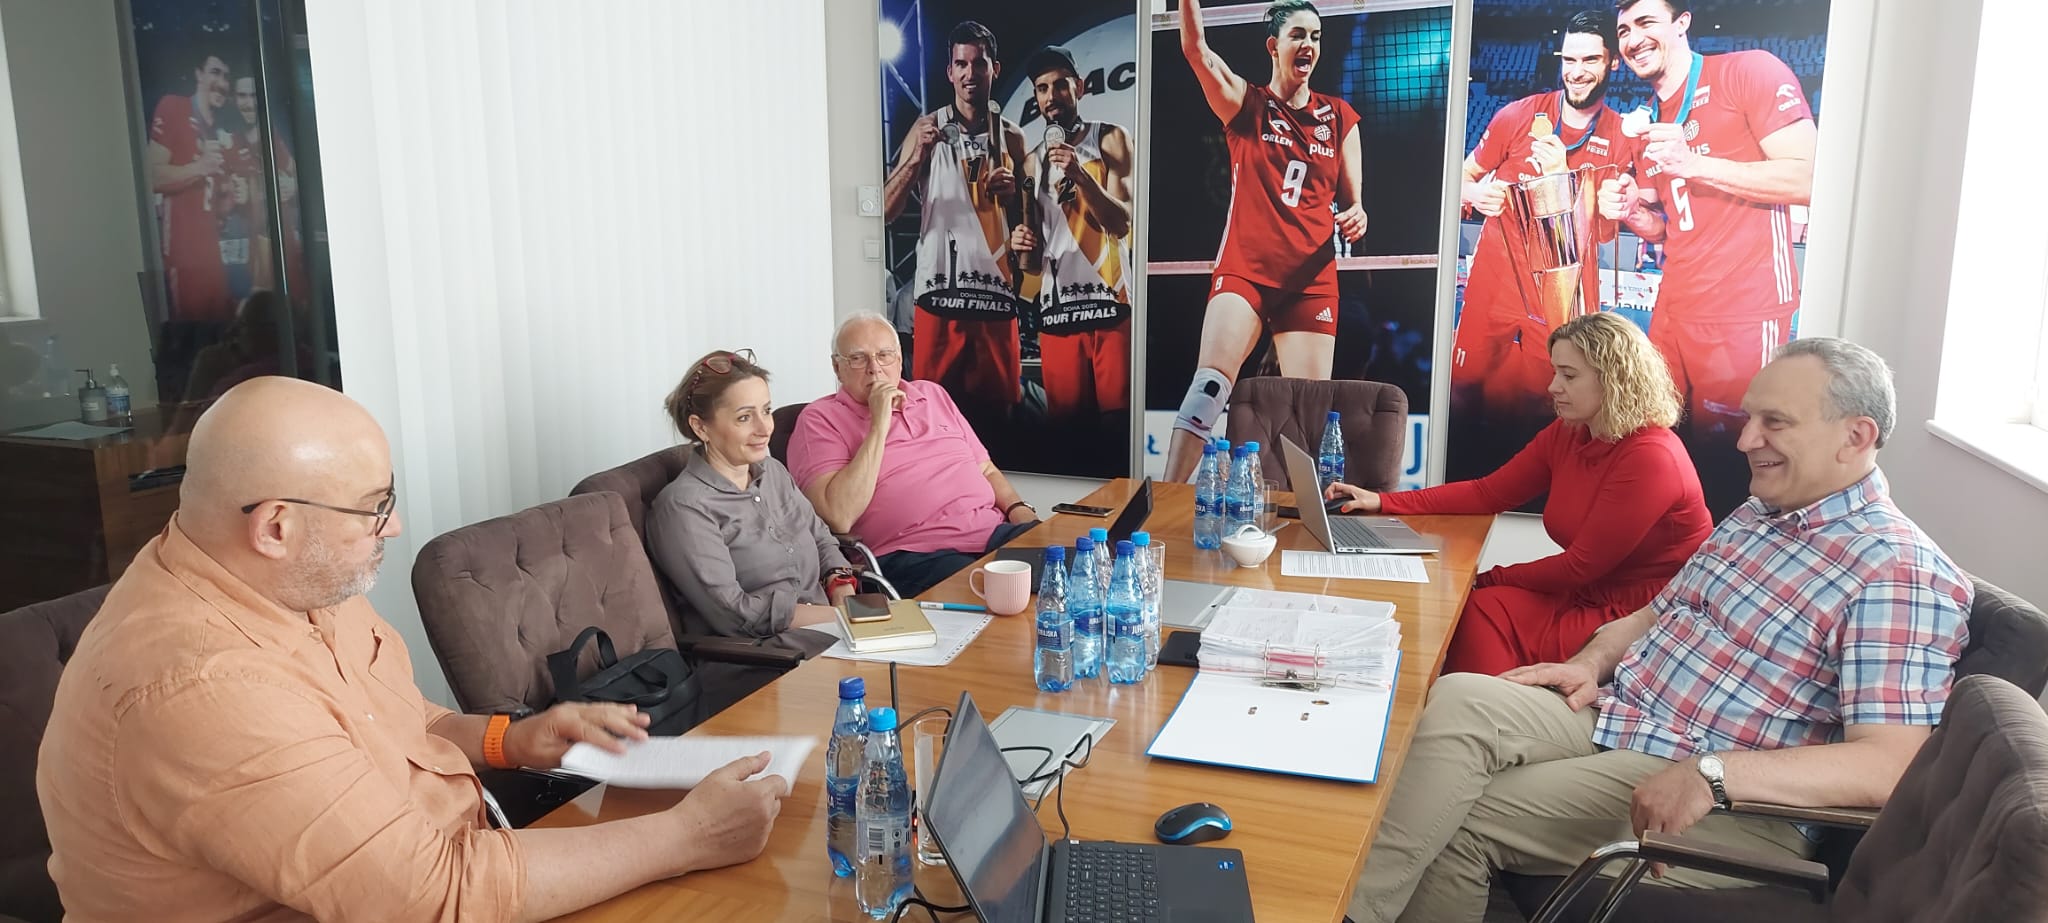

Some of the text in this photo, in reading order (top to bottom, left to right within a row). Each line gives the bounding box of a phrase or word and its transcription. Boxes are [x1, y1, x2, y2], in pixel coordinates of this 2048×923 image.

[1262, 133, 1293, 148] ORLEN
[1309, 143, 1335, 158] plus
[967, 156, 983, 184] 1
[1281, 160, 1307, 207] 9
[931, 296, 1011, 312] TOUR FINALS
[1042, 306, 1118, 327] TOUR FINALS
